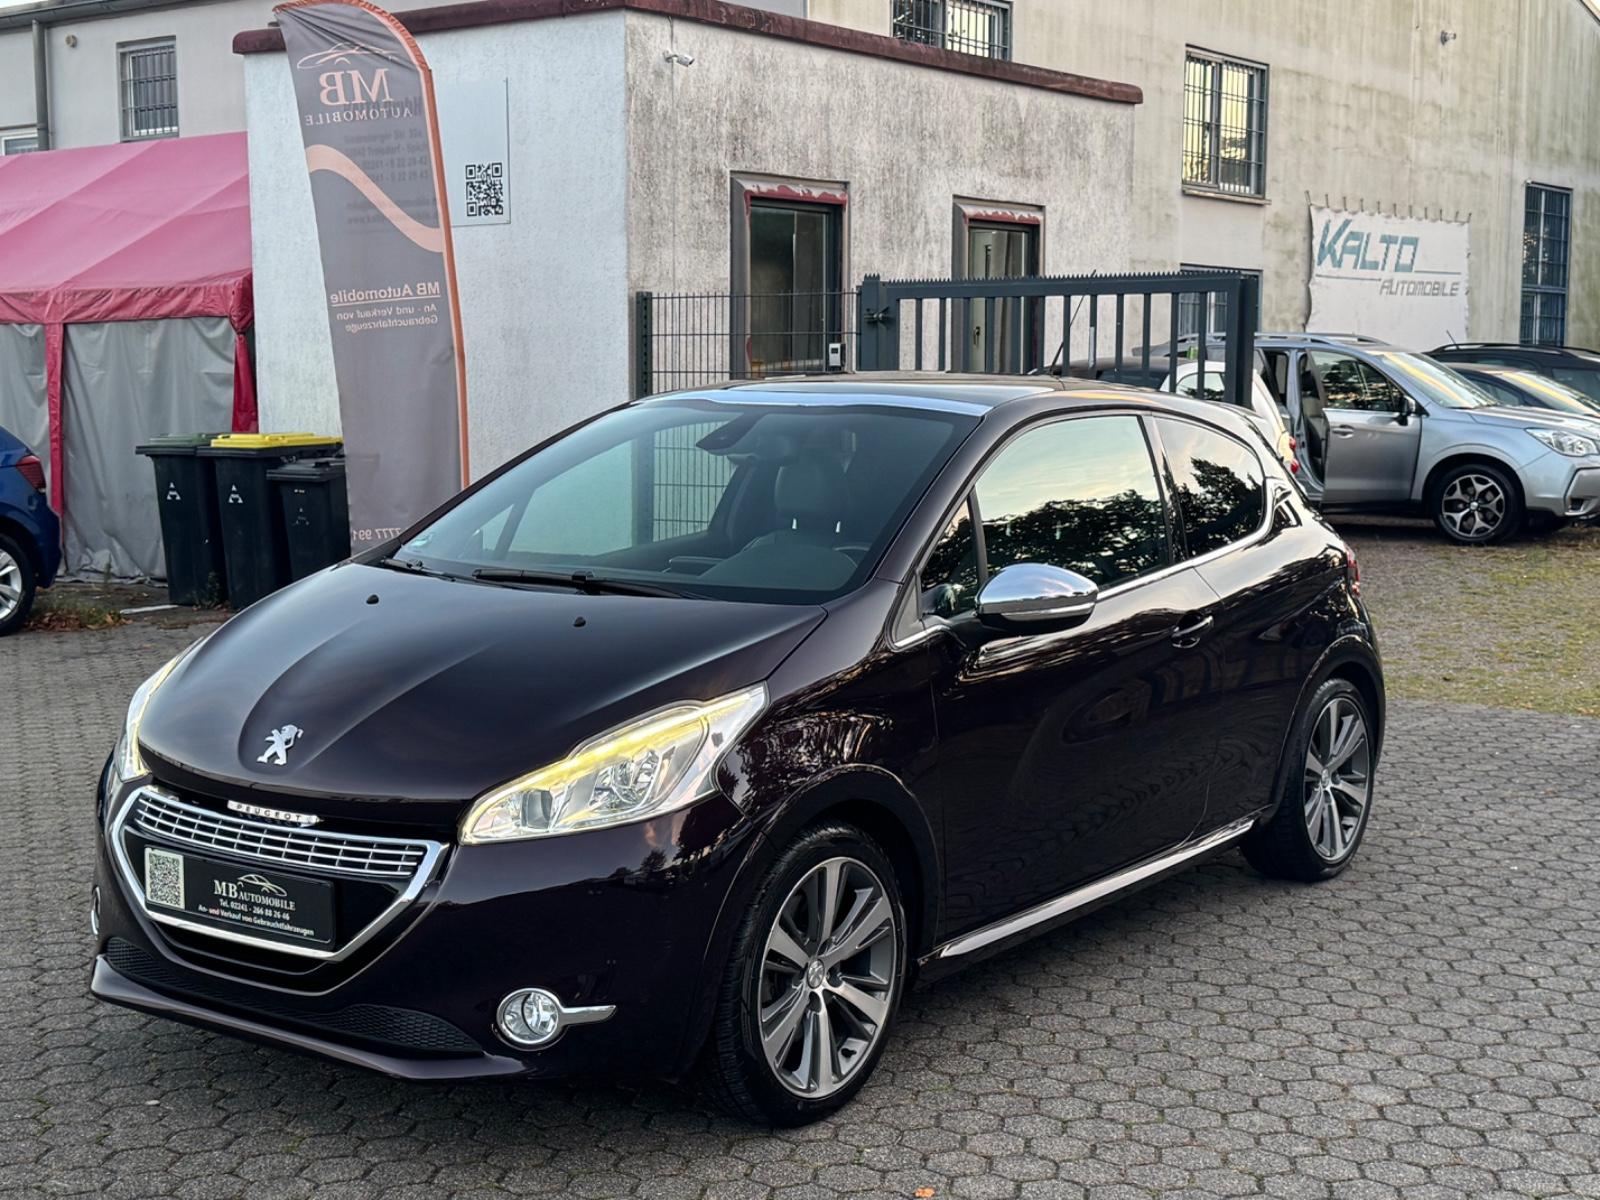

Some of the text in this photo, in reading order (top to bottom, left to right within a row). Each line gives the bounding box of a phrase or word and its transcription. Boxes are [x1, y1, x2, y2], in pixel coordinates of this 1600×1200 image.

[1317, 219, 1419, 272] KALTO
[1379, 278, 1460, 297] AUTOMOBILE
[236, 803, 302, 822] PEUGEOT
[213, 879, 296, 912] MB AUTOMOBILE
[220, 909, 242, 920] Verkauf
